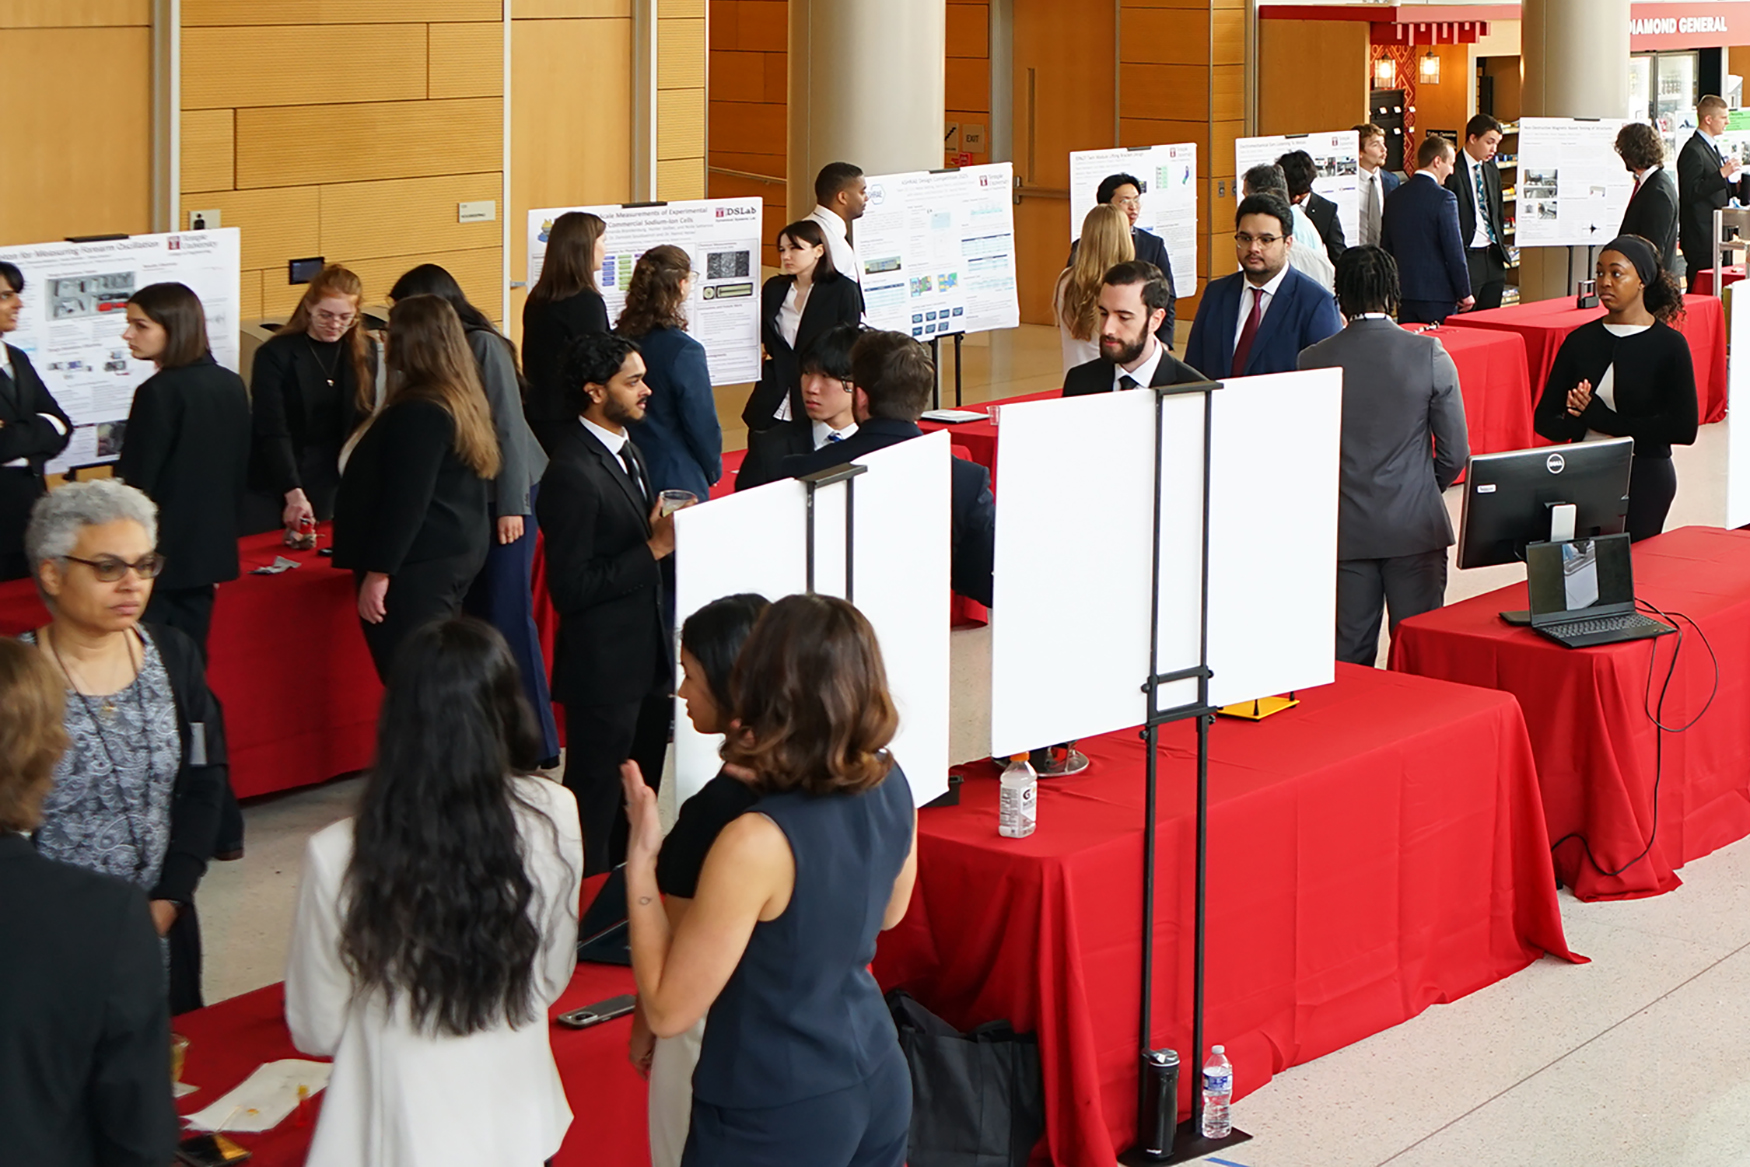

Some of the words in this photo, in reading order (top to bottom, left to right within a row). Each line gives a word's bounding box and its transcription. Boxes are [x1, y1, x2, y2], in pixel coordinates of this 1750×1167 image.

[1678, 17, 1727, 34] GENERAL
[966, 134, 979, 143] EXIT
[616, 210, 660, 218] Measurements
[669, 207, 708, 216] Experimental
[726, 206, 757, 216] DSLab
[607, 220, 643, 228] Commercial
[644, 218, 678, 227] Sodium-Ion
[35, 247, 79, 258] Measuring
[81, 244, 115, 253] Forearm
[116, 241, 159, 251] Oscillation
